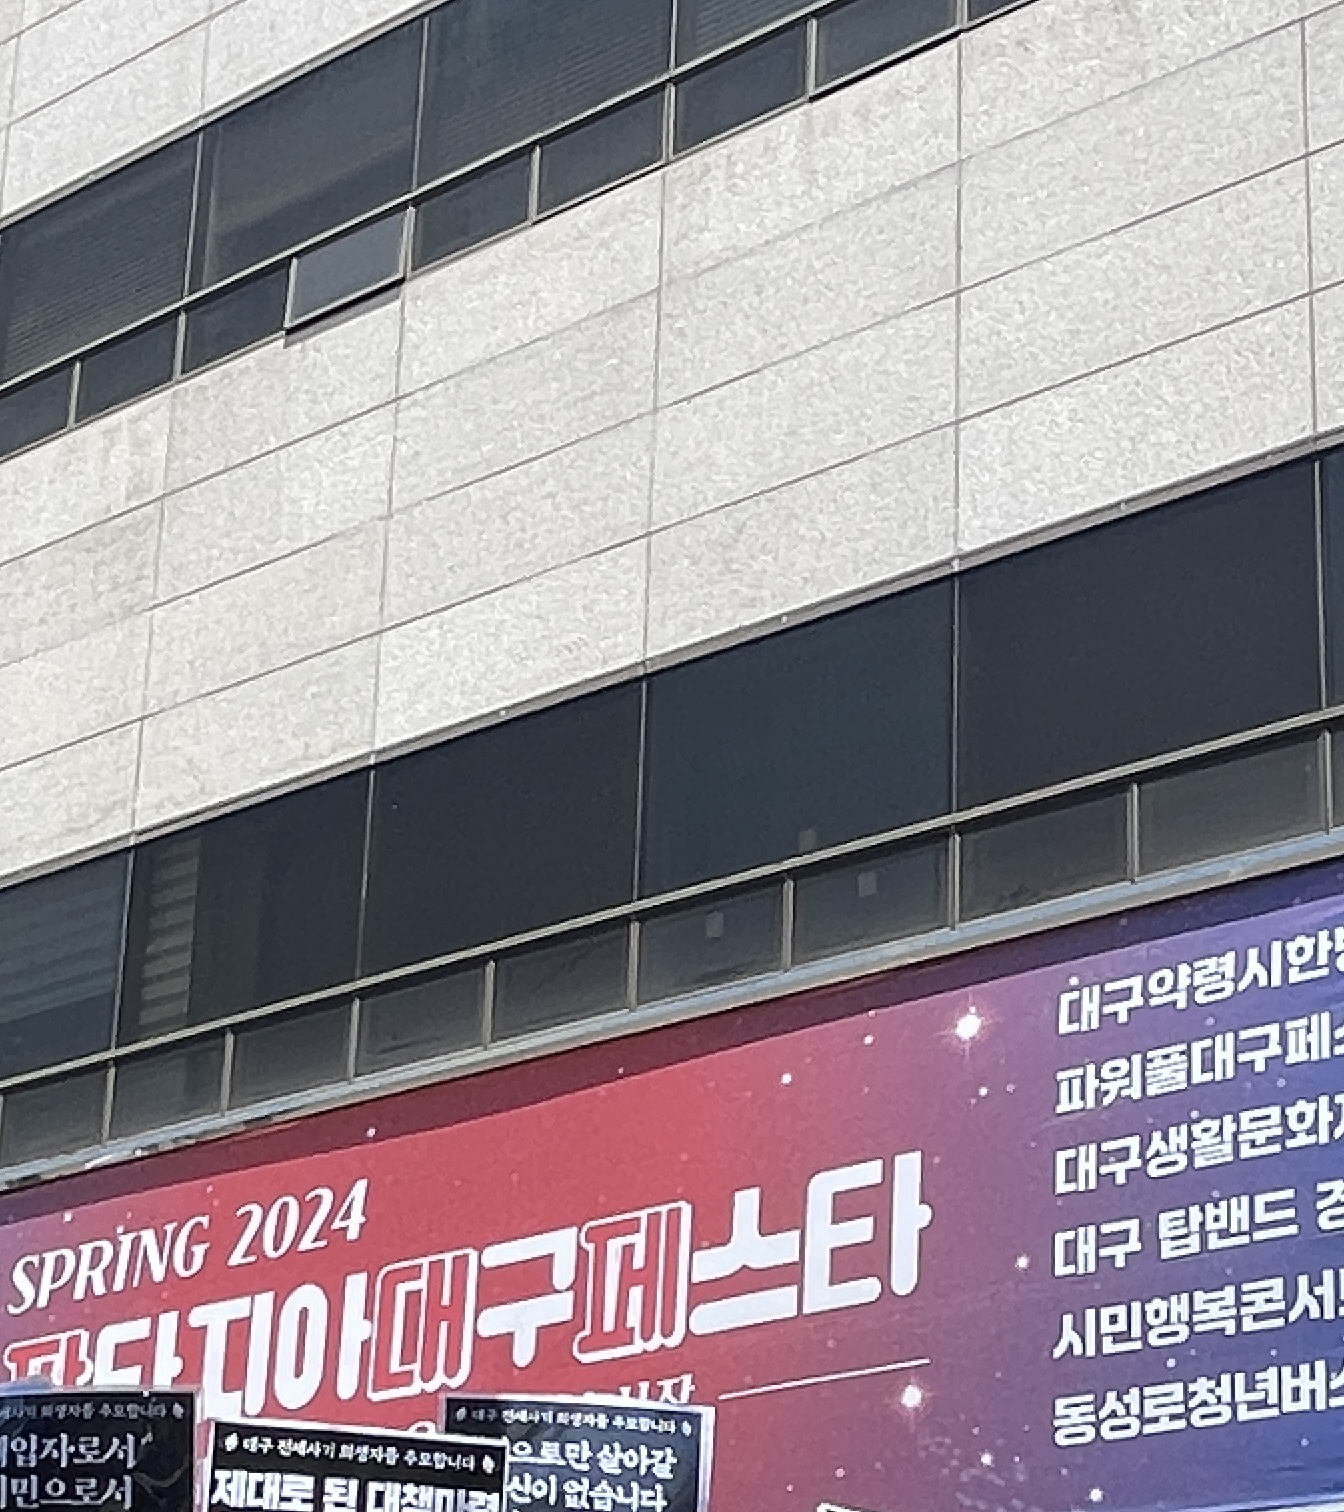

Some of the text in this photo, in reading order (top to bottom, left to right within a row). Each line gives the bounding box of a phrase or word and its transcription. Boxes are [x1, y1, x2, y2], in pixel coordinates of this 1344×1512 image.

[228, 1179, 368, 1267] 2024
[1053, 1221, 1142, 1277] 대구
[1157, 1187, 1298, 1262] 탑밴드
[243, 1437, 273, 1454] 대구
[212, 1470, 315, 1512] 제대로
[507, 1473, 557, 1505] 신이
